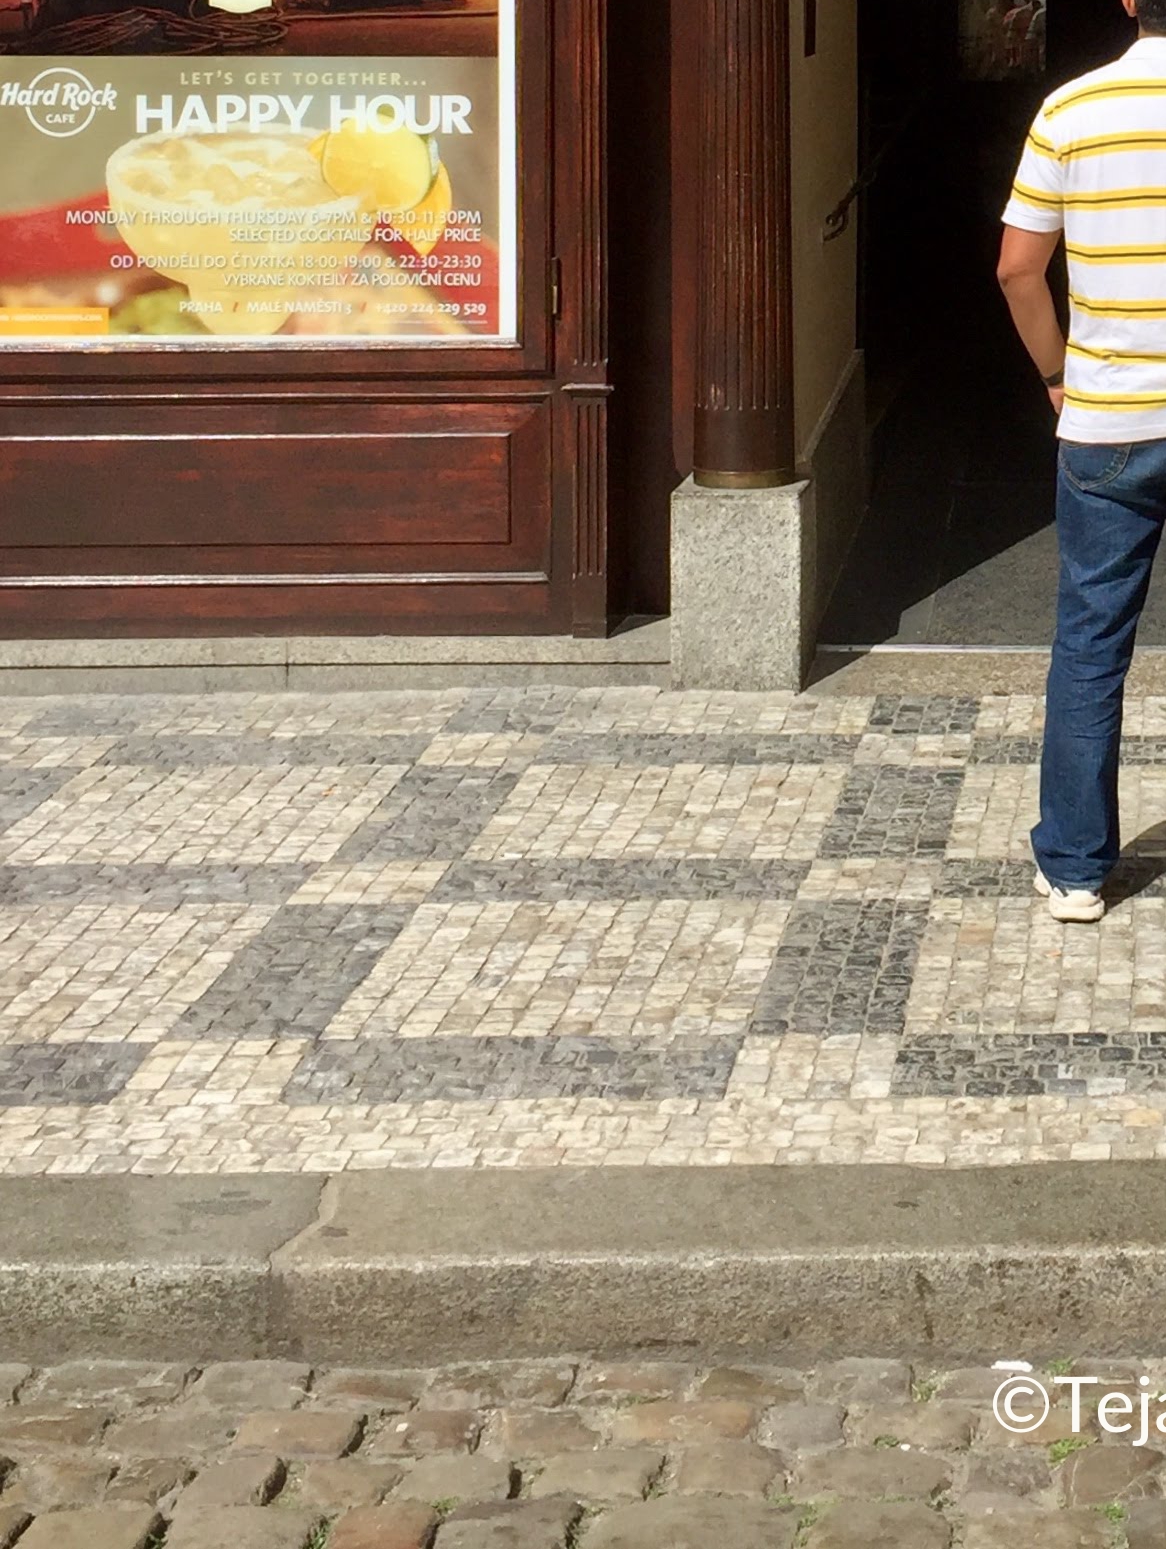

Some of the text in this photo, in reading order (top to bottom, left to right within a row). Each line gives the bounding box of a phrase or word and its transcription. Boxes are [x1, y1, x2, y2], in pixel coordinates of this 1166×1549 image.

[180, 71, 427, 86] LET'S GET TOGETHER...
[0, 82, 117, 110] Hard Rock
[45, 113, 76, 125] CAFE
[136, 94, 473, 134] HAPPY HOUR
[65, 210, 136, 225] MONDAY
[141, 210, 219, 225] THROUGH
[225, 210, 305, 225] THURSDAY
[229, 228, 481, 242] SELECTED COCKTAILS FOR HALF PRICE
[110, 255, 134, 268] OD
[203, 255, 226, 268] DO
[386, 256, 397, 268] &
[399, 255, 482, 268] 22:30-23:30
[351, 273, 369, 286] ZA
[444, 273, 481, 286] CENU
[179, 302, 223, 313] PRAHA
[411, 304, 434, 316] 224
[438, 304, 460, 316] 229
[463, 304, 487, 316] 529
